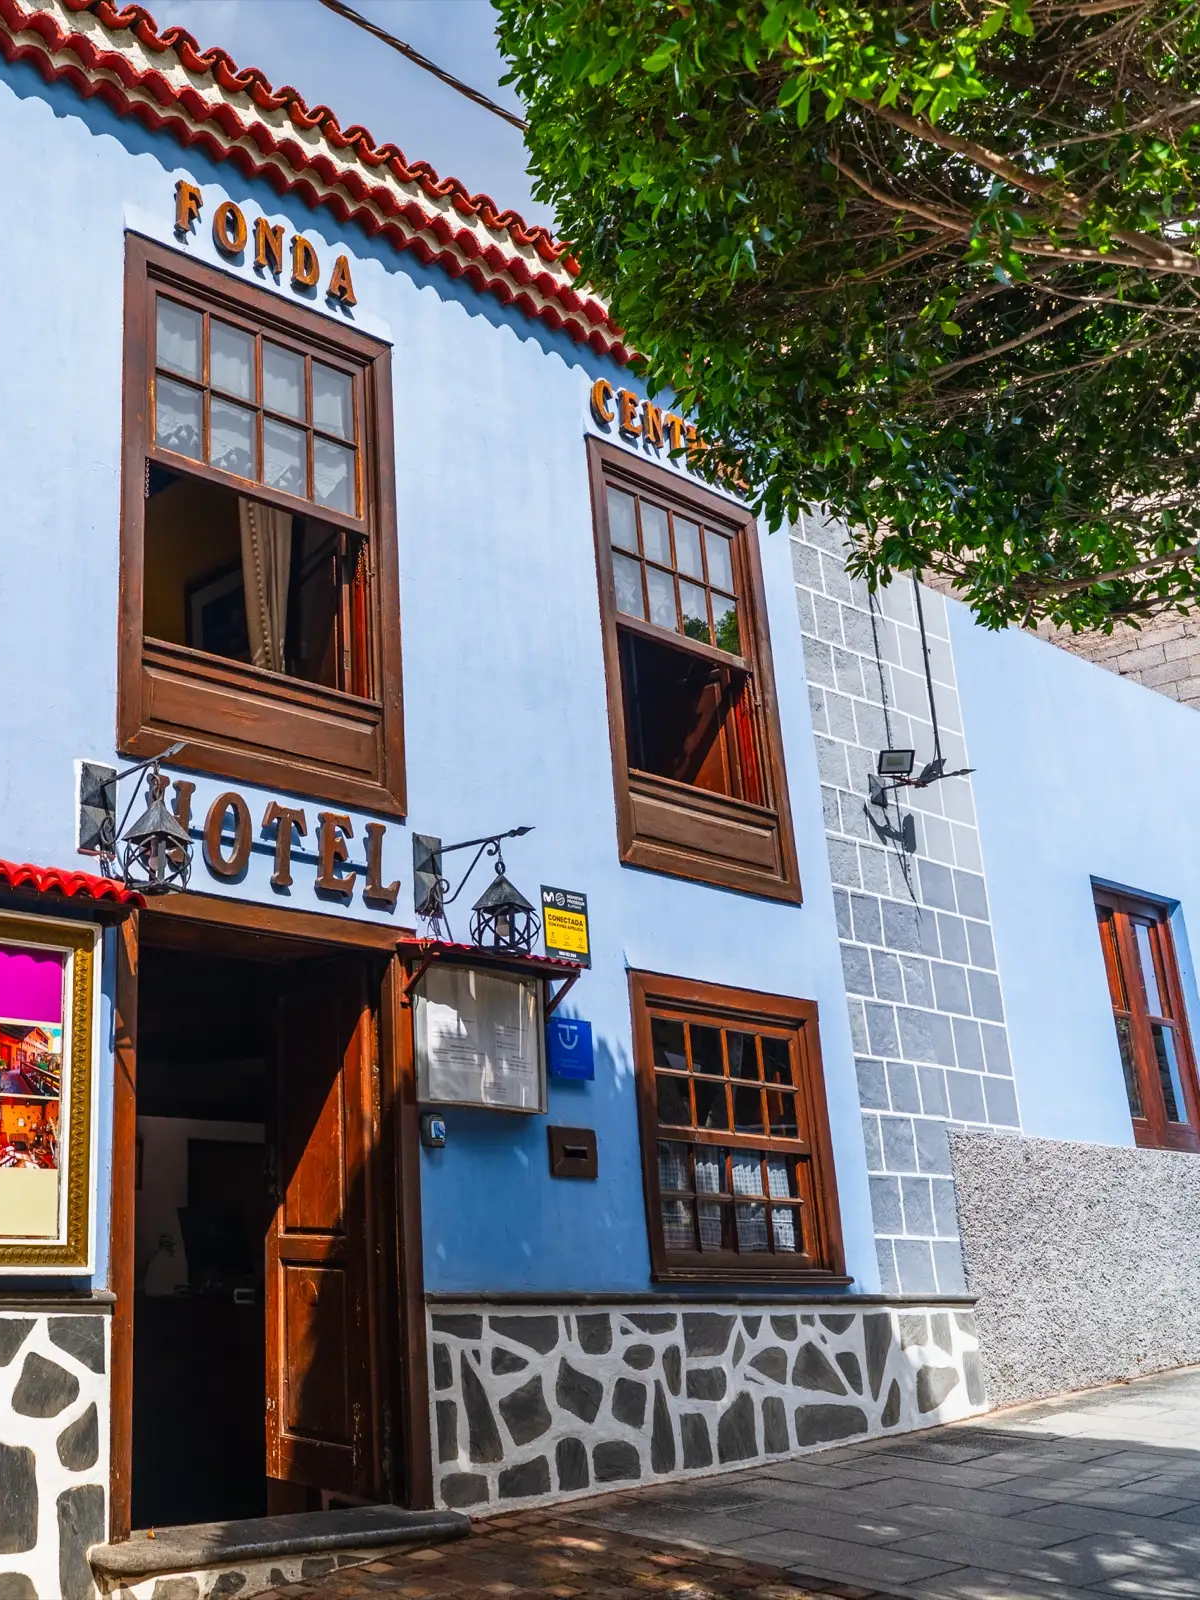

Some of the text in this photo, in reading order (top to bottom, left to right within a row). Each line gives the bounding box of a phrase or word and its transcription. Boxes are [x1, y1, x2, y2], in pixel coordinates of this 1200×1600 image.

[174, 180, 358, 307] FONDA
[590, 378, 750, 490] CENT
[548, 914, 584, 927] CONECTADA
